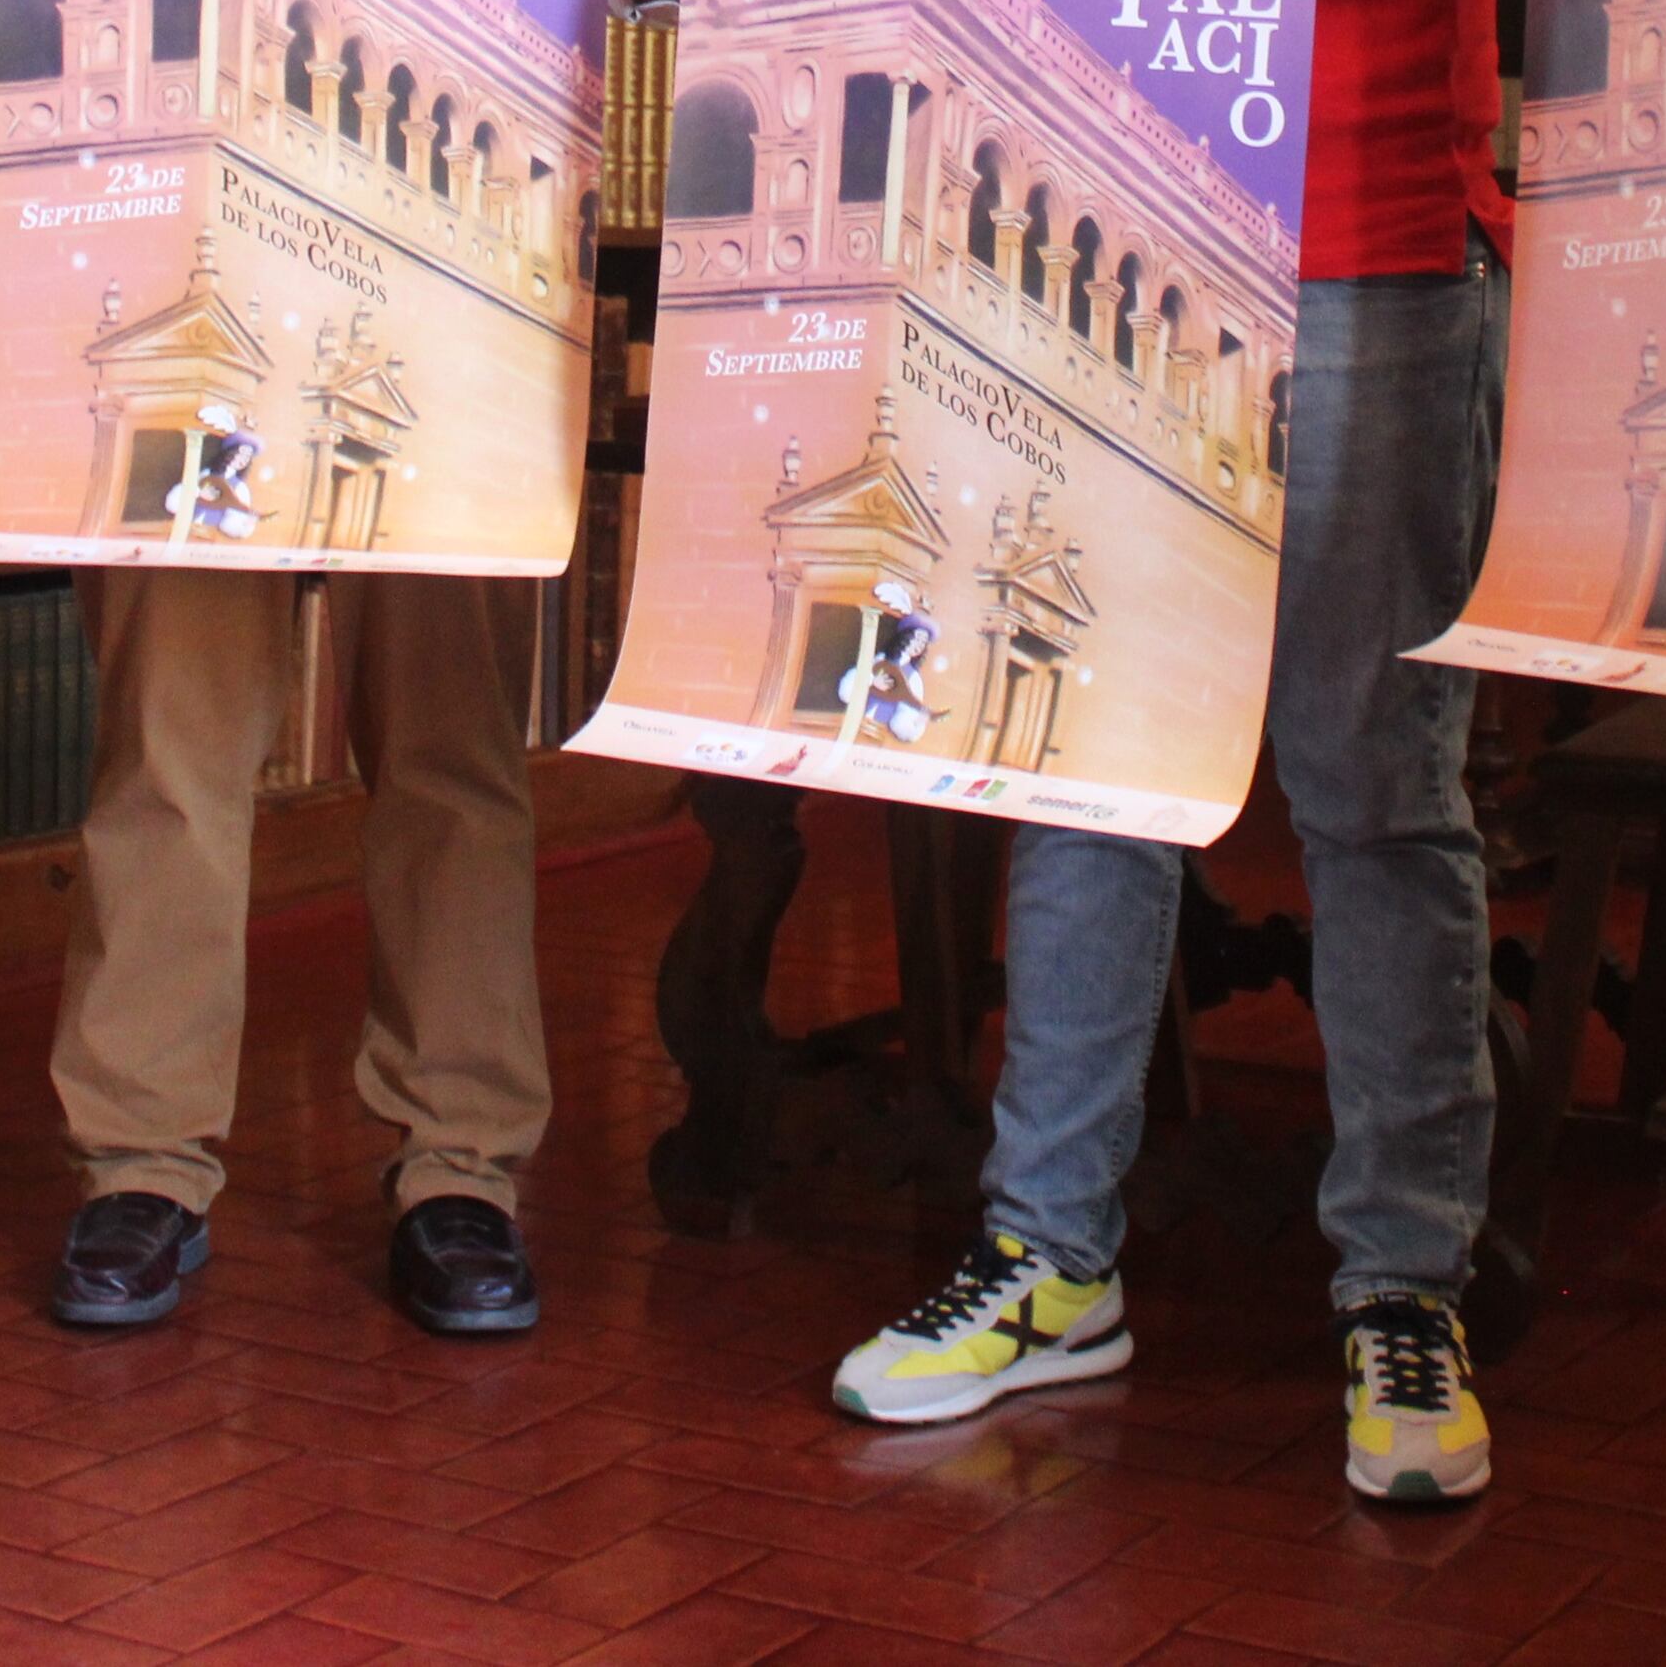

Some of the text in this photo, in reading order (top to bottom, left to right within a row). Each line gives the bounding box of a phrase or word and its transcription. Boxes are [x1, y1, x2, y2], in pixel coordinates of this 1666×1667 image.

[1147, 18, 1279, 86] ACI
[1230, 90, 1285, 147] O
[104, 163, 185, 195] 23 DE
[221, 201, 387, 305] DE LOS COBOS
[788, 312, 867, 344] 23 DE
[901, 359, 1066, 486] DE LOS COBOS
